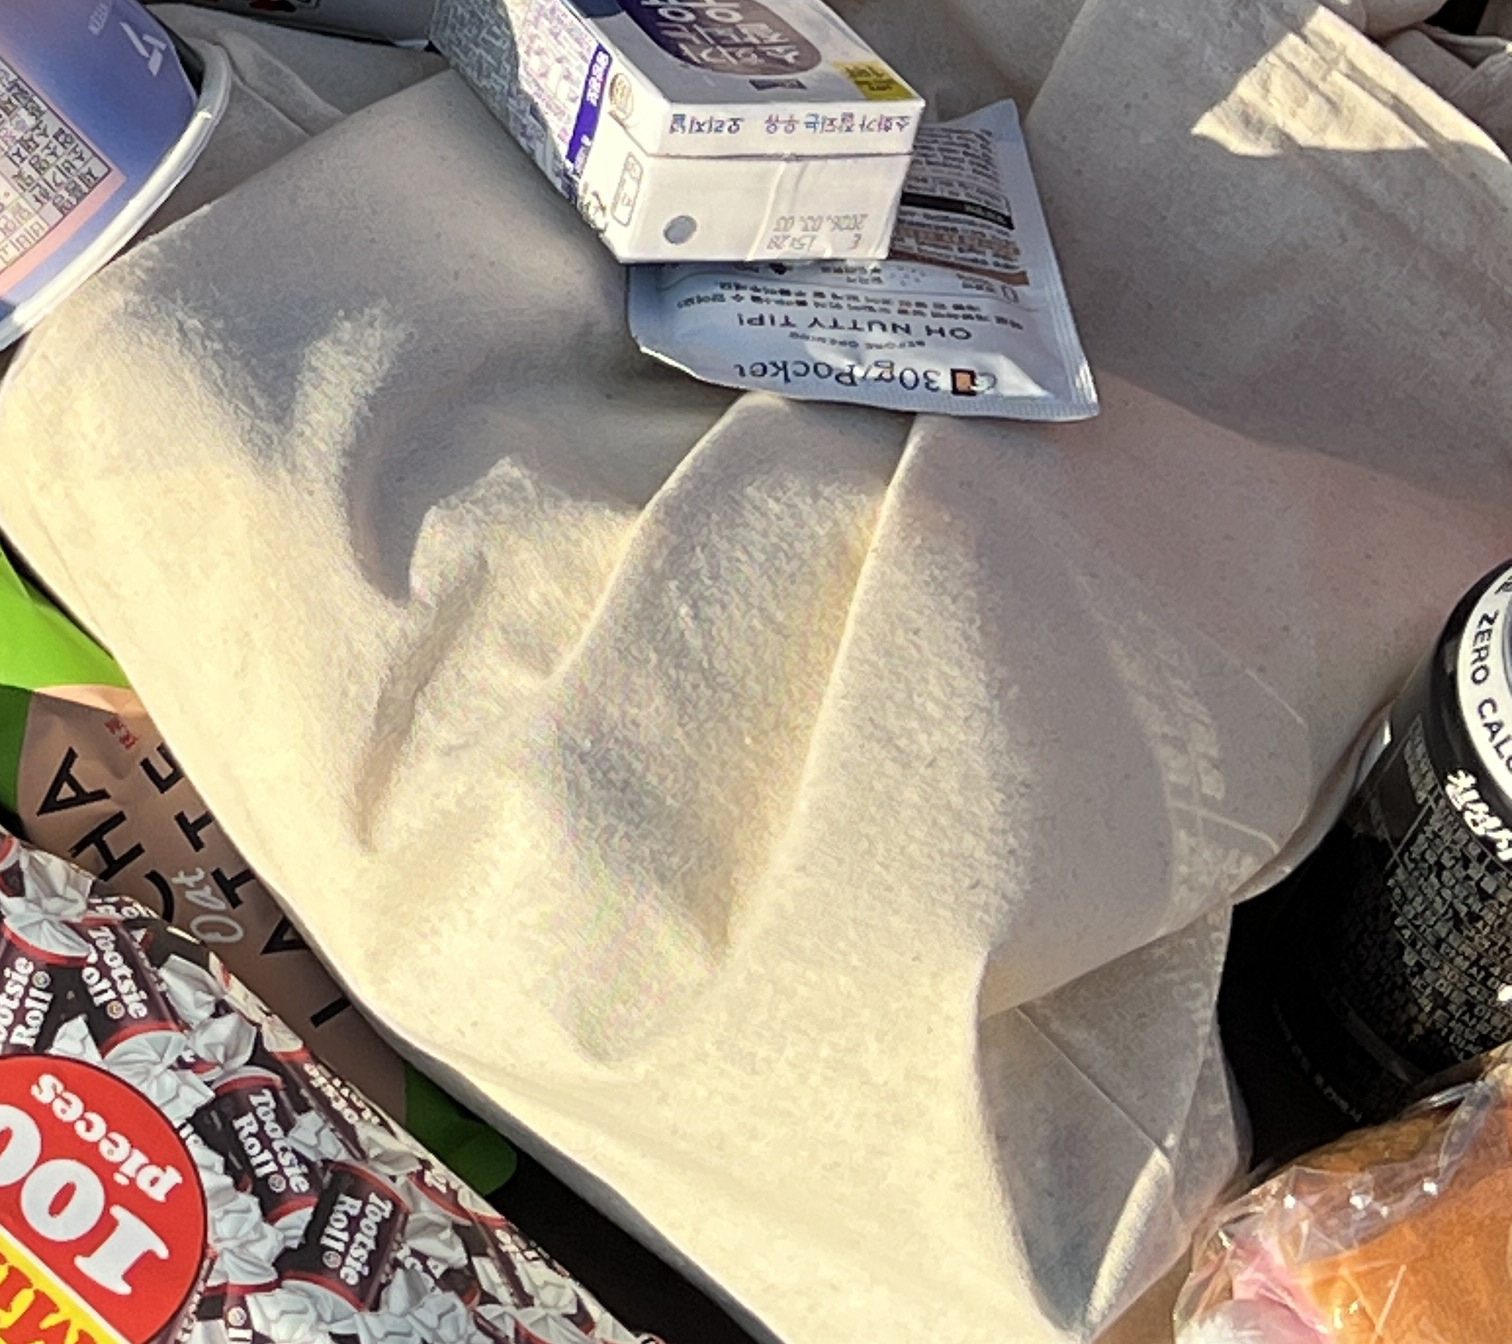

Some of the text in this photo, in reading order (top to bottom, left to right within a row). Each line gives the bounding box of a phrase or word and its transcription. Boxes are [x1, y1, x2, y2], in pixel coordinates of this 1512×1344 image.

[669, 113, 910, 133] 소화가 잘되는 우유 오리지널
[735, 312, 971, 341] OH NUTTY TIP!
[1469, 610, 1497, 686] ZERO
[157, 857, 253, 958] Oat
[83, 920, 150, 1021] Tootsie
[11, 988, 54, 1051] Roll
[29, 1072, 184, 1207] pieces
[227, 1108, 279, 1182] Roll
[247, 1086, 312, 1194] Tootsie
[313, 1190, 363, 1259] Roll
[336, 1190, 395, 1288] Tootsie
